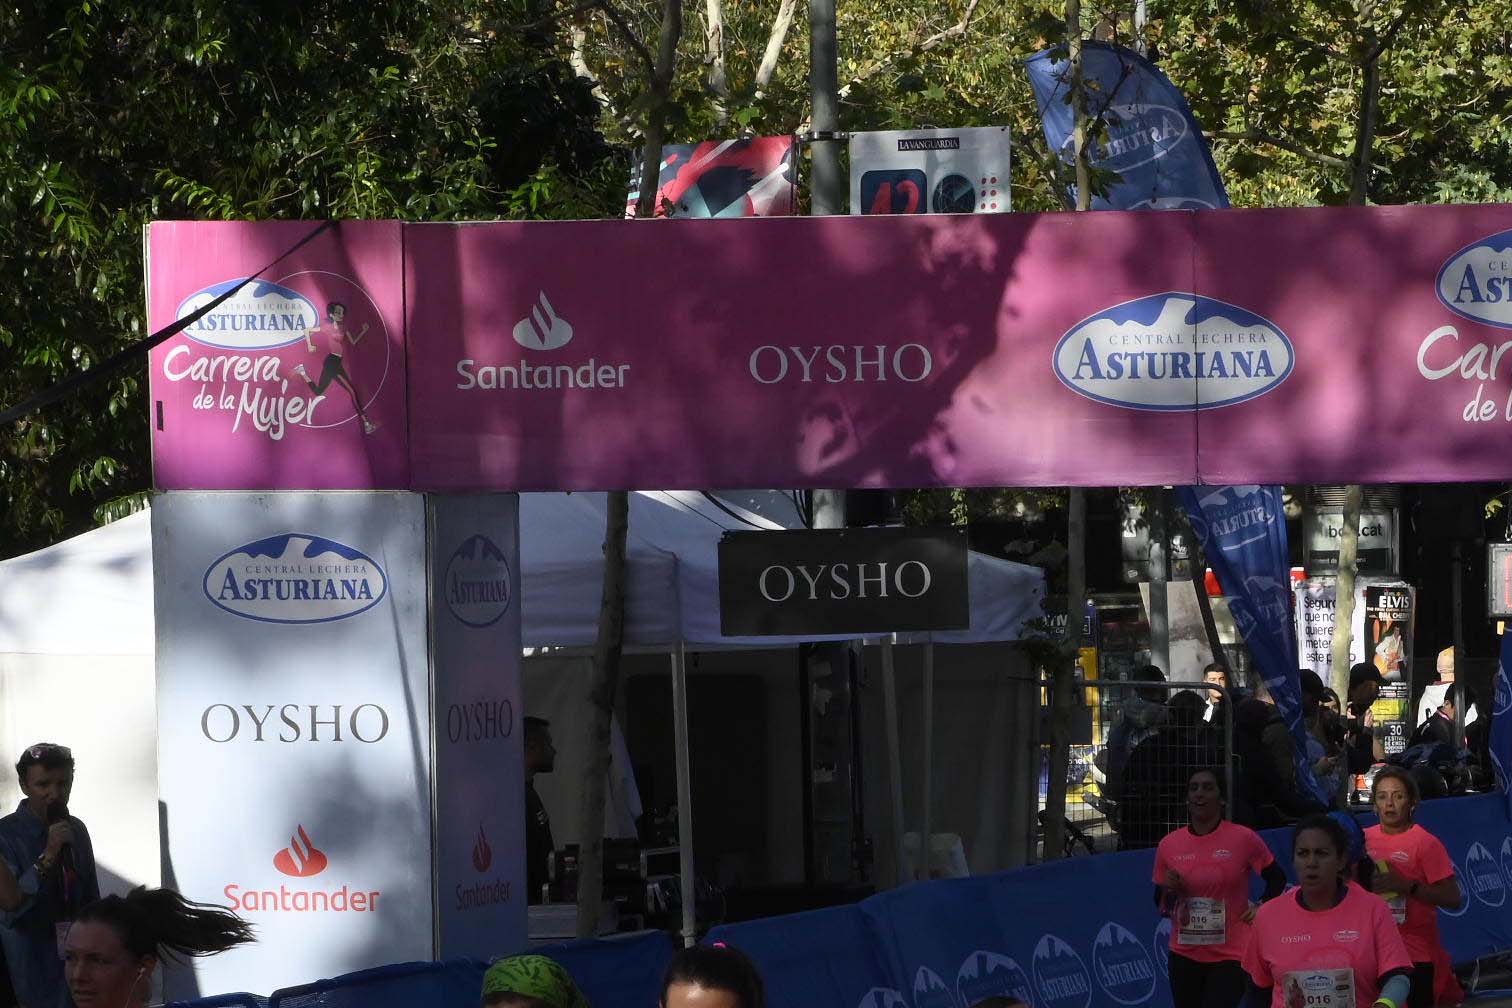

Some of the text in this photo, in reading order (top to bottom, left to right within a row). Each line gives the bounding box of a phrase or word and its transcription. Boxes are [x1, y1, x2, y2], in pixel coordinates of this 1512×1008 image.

[909, 138, 959, 150] VANGUARDIA
[187, 305, 307, 332] ASTURIANA
[1108, 331, 1268, 346] CENTRAL LECHERA
[163, 344, 281, 382] Carrera
[456, 357, 631, 391] Santander
[748, 342, 933, 384] OYSHO
[1071, 336, 1276, 380] ASTURIANA
[192, 378, 327, 440] de la Mujer
[1461, 384, 1499, 423] de
[217, 567, 374, 602] ASTURIANA
[245, 564, 368, 575] CENTRAL LECHERA
[758, 560, 932, 602] OYSHO
[450, 571, 509, 607] ASTURIANA
[1379, 595, 1409, 608] ELVIS
[1305, 625, 1334, 635] quiere
[200, 702, 389, 744] OYSHO
[447, 698, 513, 743] OYSHO
[223, 884, 380, 913] Santander
[455, 881, 511, 912] Santander
[1307, 994, 1331, 1005] 016
